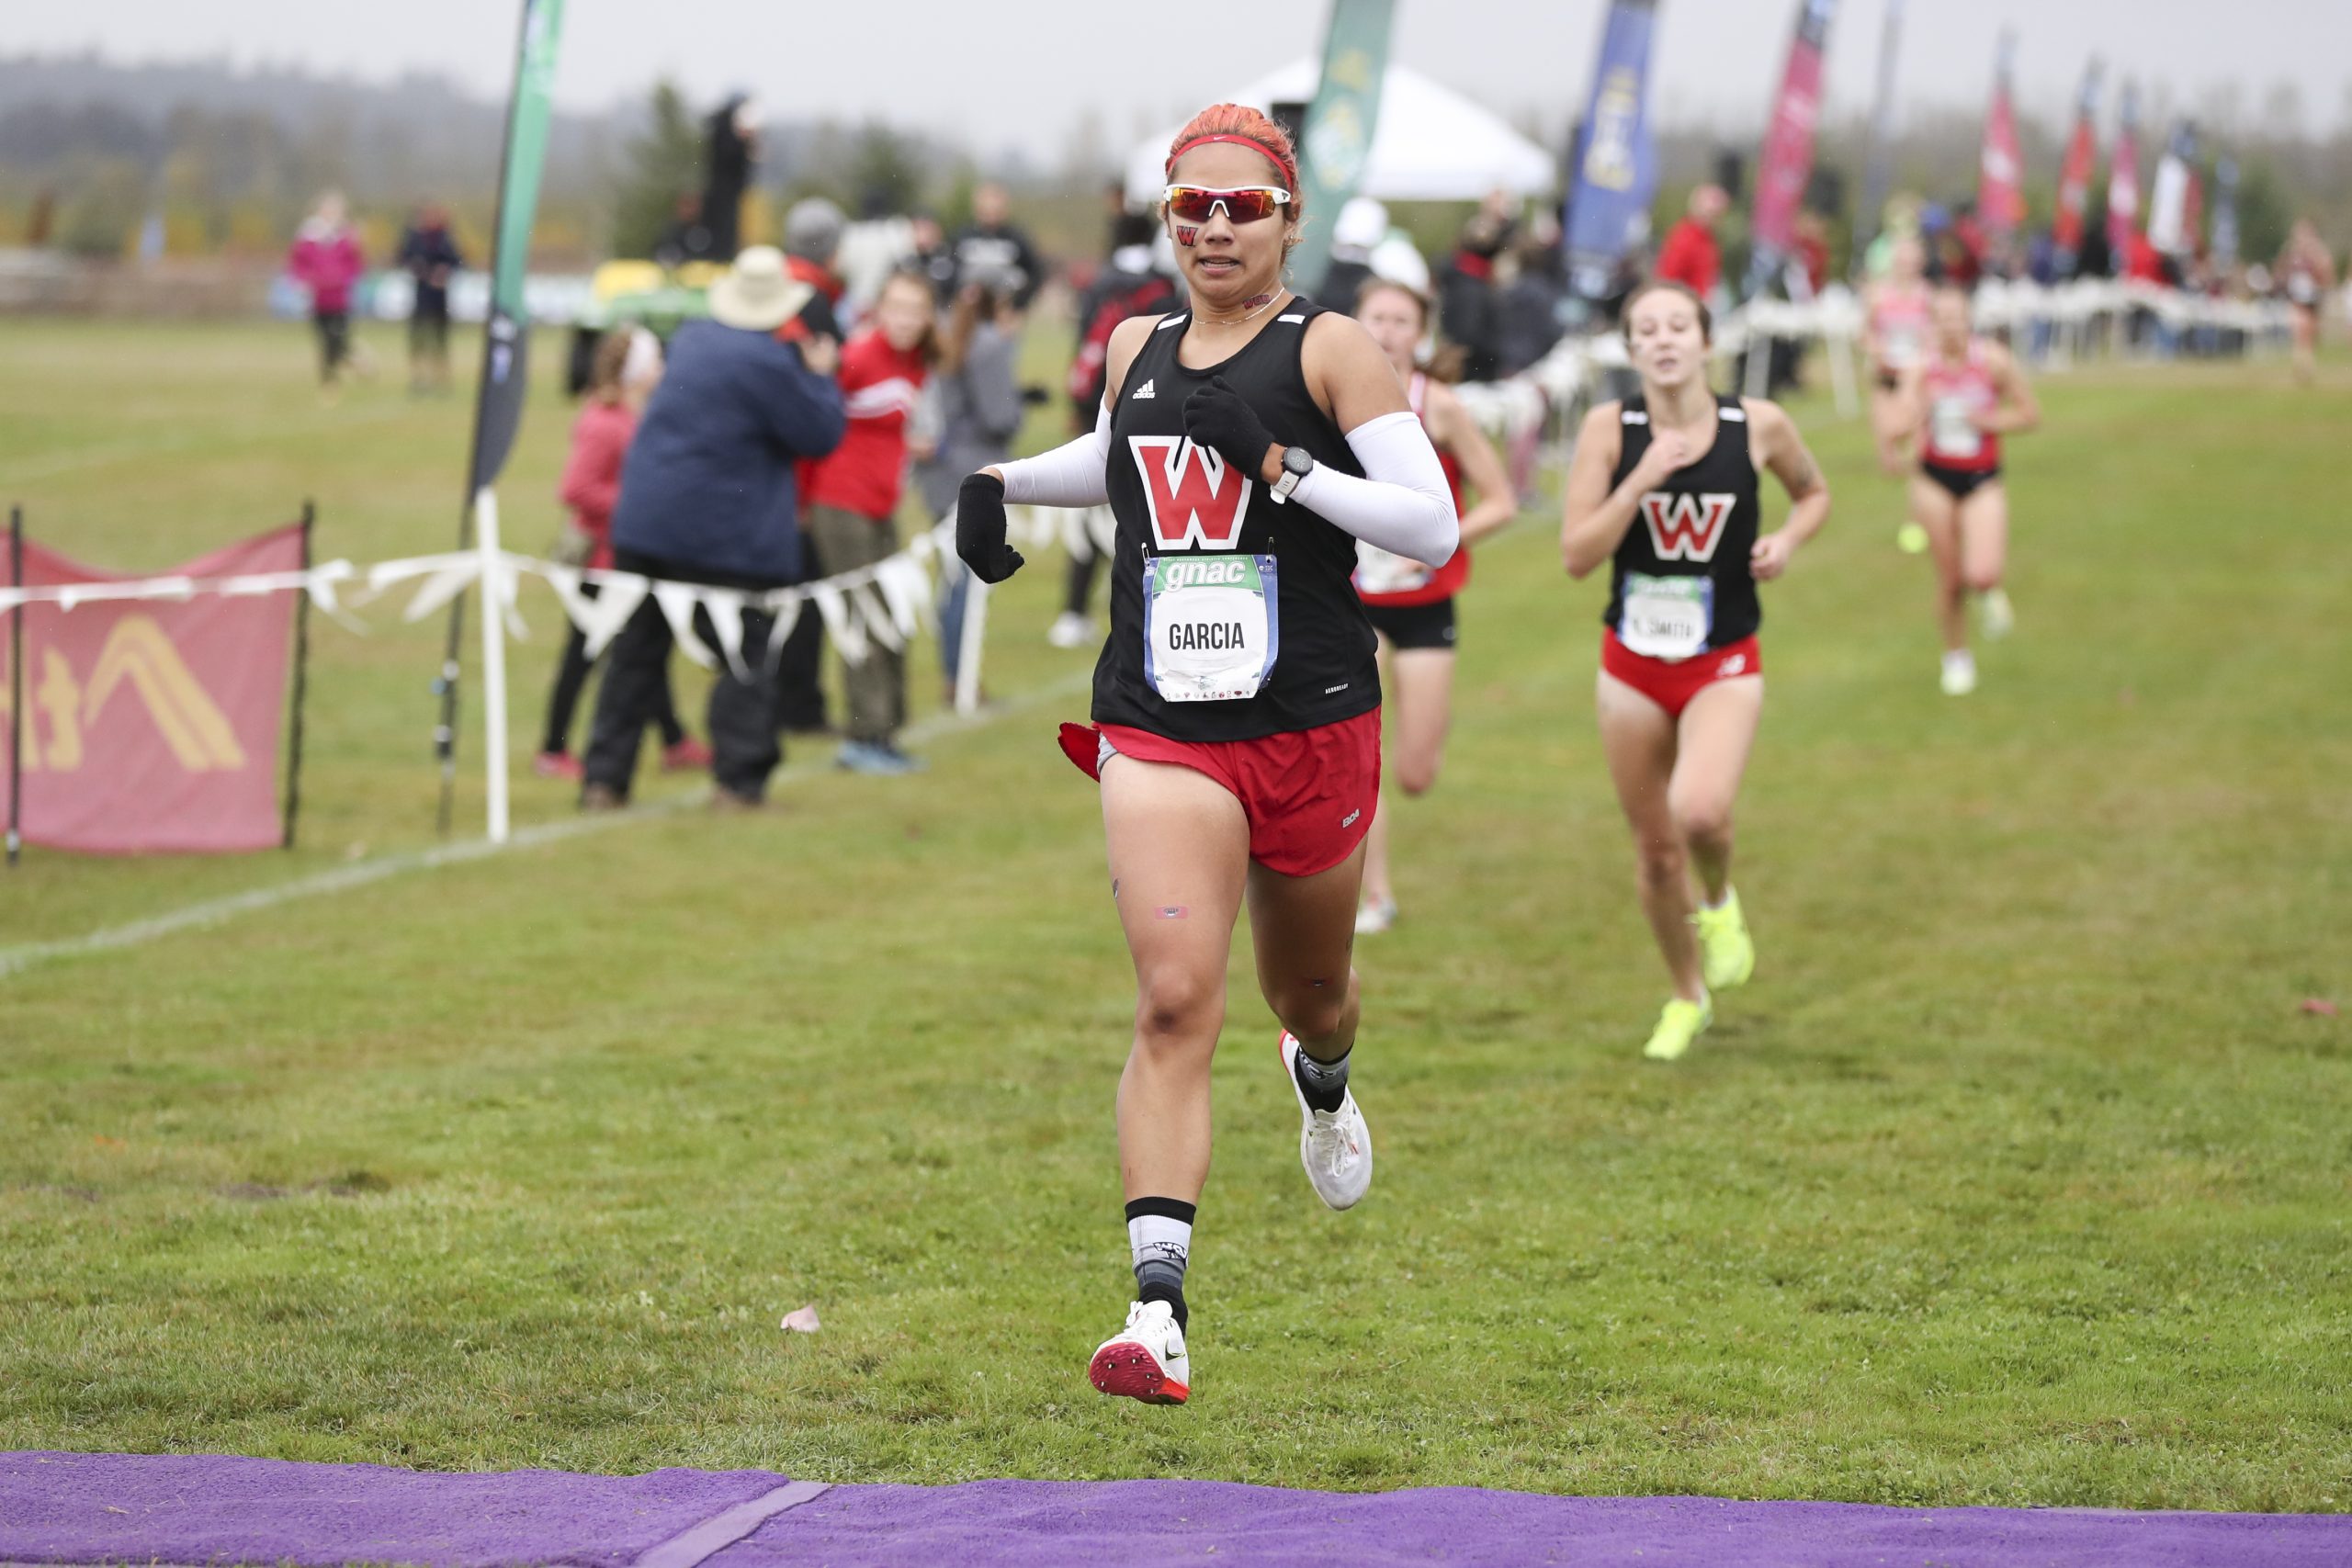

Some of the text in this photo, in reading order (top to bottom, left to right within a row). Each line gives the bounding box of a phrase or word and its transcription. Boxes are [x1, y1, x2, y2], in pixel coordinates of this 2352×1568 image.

[1176, 225, 1198, 247] W
[1132, 391, 1156, 400] adidas
[1127, 434, 1253, 551] W
[1640, 491, 1736, 563] W
[1165, 560, 1246, 592] gnac
[1169, 622, 1245, 650] GARCIA
